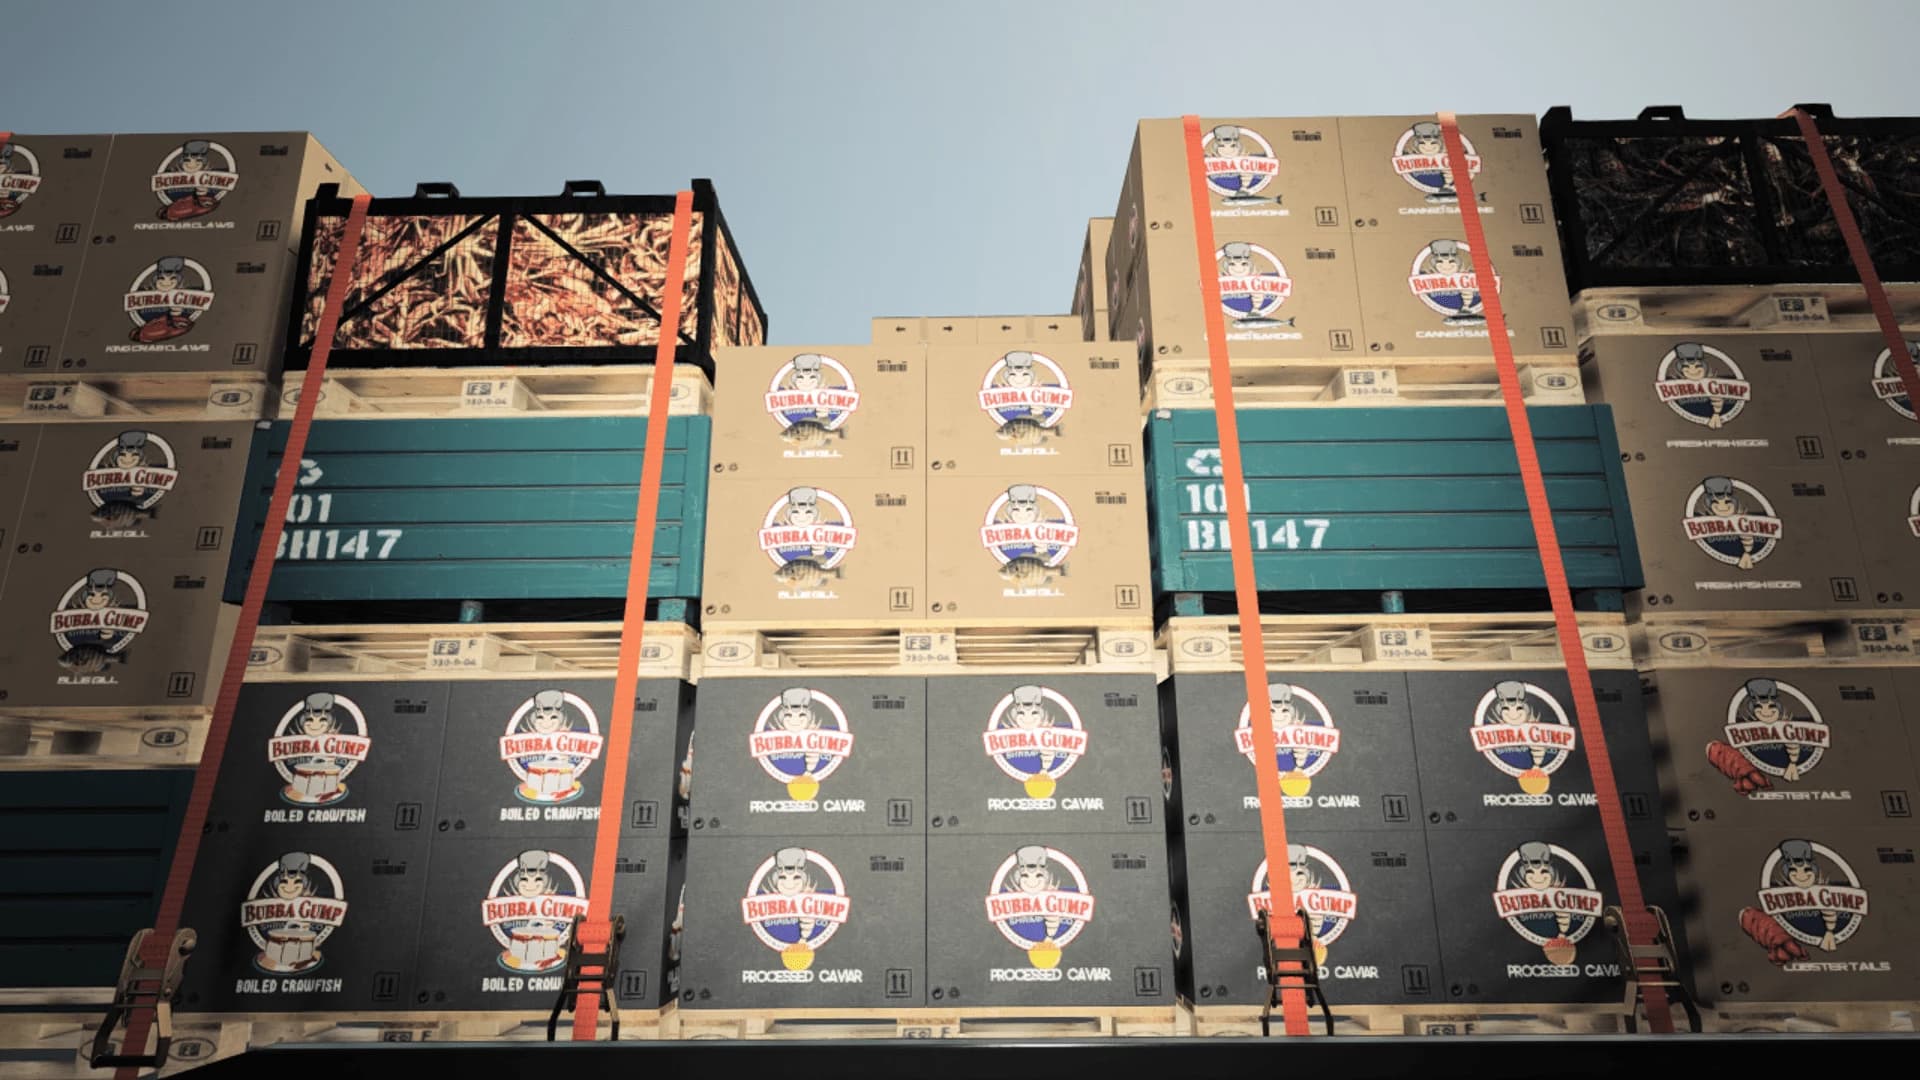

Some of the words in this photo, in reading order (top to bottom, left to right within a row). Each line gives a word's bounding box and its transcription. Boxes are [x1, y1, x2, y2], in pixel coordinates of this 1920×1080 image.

[1205, 160, 1236, 173] UBBA
[1396, 156, 1439, 171] BUBBA
[154, 175, 196, 188] BUBBA
[198, 173, 236, 188] GUMP
[0, 224, 35, 232] LAWS
[1412, 277, 1457, 292] BUBBA
[127, 294, 170, 308] BUBBA
[172, 291, 210, 307] GUMP
[983, 391, 1027, 406] BUBBA
[1031, 388, 1070, 405] GUMP
[1659, 383, 1704, 398] BUBBA
[1708, 380, 1748, 398] GUMP
[1877, 381, 1906, 396] BUB
[769, 393, 813, 408] BUBBA
[817, 391, 856, 407] GUMP
[86, 471, 131, 487] BUBBA
[134, 468, 175, 486] GUMP
[270, 494, 332, 523] 01
[985, 527, 1032, 543] BUBBA
[1035, 524, 1075, 542] GUMP
[1688, 519, 1735, 536] BUBBA
[1738, 516, 1780, 535] GUMP
[763, 529, 809, 545] BUBBA
[813, 527, 853, 544] GUMP
[54, 613, 101, 630] BUBBA
[104, 610, 145, 628] GUMP
[754, 734, 803, 753] BUBBA
[806, 732, 849, 752] GUMP
[988, 732, 1040, 751] BUBBA
[1040, 729, 1083, 750] GUMP
[1240, 731, 1290, 749] BBA
[1293, 728, 1335, 749] GUMP
[1475, 728, 1527, 746] BUBBA
[1529, 725, 1573, 746] GUMP
[1730, 727, 1780, 744] BUBBA
[1783, 723, 1827, 743] GUMP
[272, 738, 320, 758] BUBBA
[324, 736, 367, 757] GUMP
[504, 737, 553, 756] BUBBA
[556, 734, 600, 755] GUMP
[750, 799, 818, 812] PROCESSED
[823, 799, 866, 812] CAVIAR
[987, 798, 1056, 811] PROCESSED
[1061, 798, 1104, 811] CAVIAR
[1317, 796, 1360, 808] CAVIAR
[1483, 794, 1553, 806] PROCESSED
[263, 809, 304, 823] BOILED
[307, 808, 367, 823] CRAWFISH
[501, 807, 541, 821] BOILED
[747, 899, 798, 918] BUBBA
[801, 896, 846, 917] GUMP
[990, 897, 1042, 917] BUBBA
[1045, 894, 1090, 916] GUMP
[1307, 890, 1353, 912] GUMP
[1498, 893, 1551, 913] BUBBA
[1553, 890, 1599, 912] GUMP
[1763, 892, 1817, 911] BUBBA
[1819, 888, 1865, 910] GUMP
[245, 902, 296, 924] BUBBA
[299, 899, 344, 922] GUMP
[486, 901, 538, 922] BUBBA
[742, 970, 815, 983] PROCESSED
[819, 969, 863, 983] CAVIAR
[990, 968, 1063, 981] PROCESSED
[1067, 967, 1112, 981] CAVIAR
[1334, 965, 1379, 979] CAVIAR
[1506, 964, 1580, 978] PROCESSED
[1584, 964, 1621, 978] CAVIA
[236, 978, 278, 993] BOILED
[281, 978, 342, 993] CRAWFISH
[482, 976, 524, 992] BOILED
[527, 976, 563, 991] CRAW
